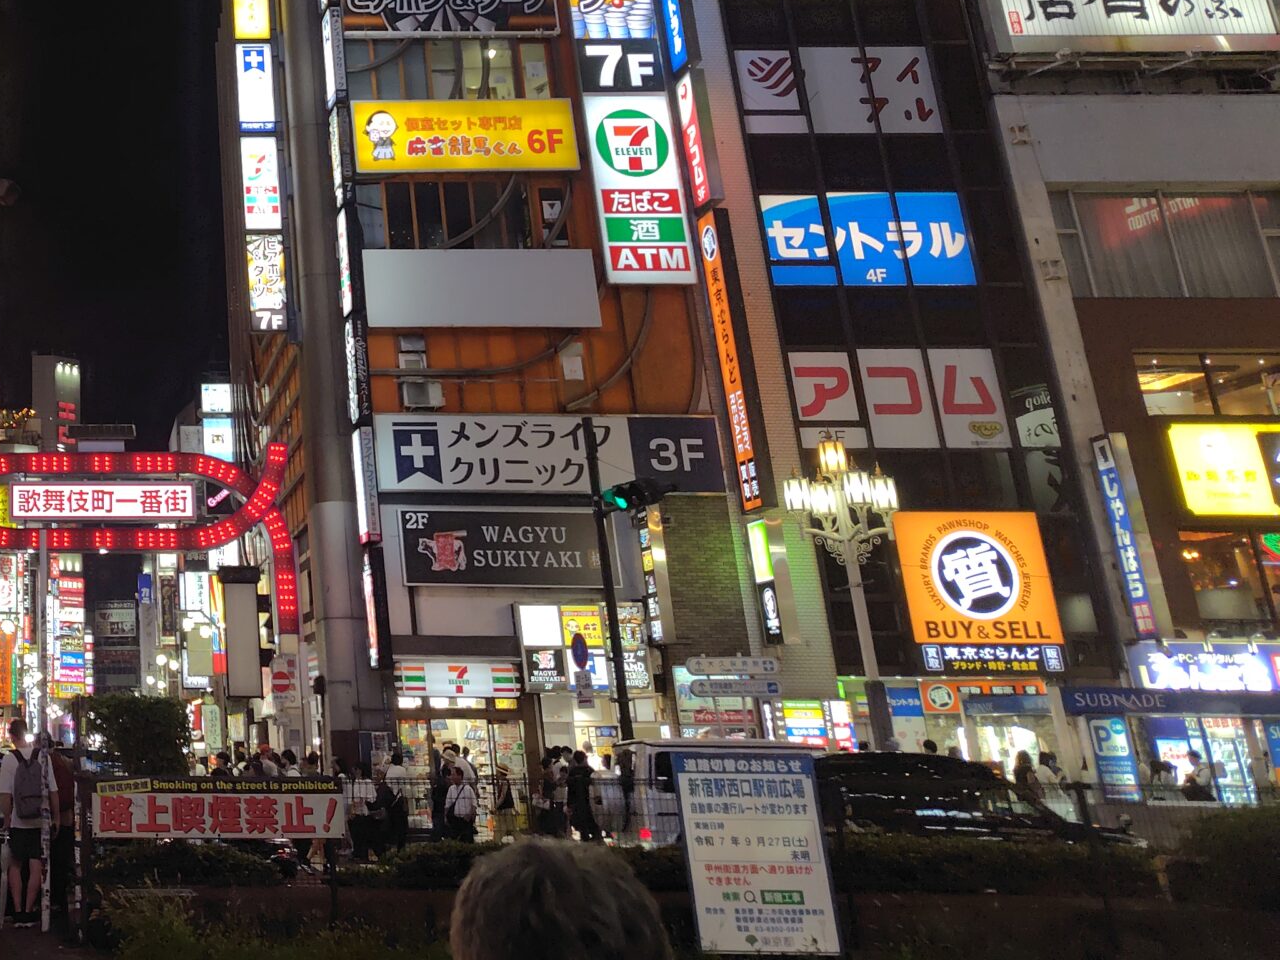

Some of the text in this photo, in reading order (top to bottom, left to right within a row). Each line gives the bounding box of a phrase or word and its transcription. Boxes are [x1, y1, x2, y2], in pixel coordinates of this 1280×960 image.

[585, 44, 654, 87] 7F
[407, 129, 563, 157] 麻雀龍馬くん 6F
[614, 147, 652, 157] ELEVEN
[685, 128, 705, 188] アコム
[611, 191, 674, 212] たばこ
[630, 219, 660, 241] 酒
[767, 220, 968, 260] セントラル
[617, 248, 684, 270] ATM
[866, 268, 888, 283] 4F
[255, 310, 284, 331] 7F
[793, 364, 997, 418] アコム
[728, 392, 745, 454] RESALE
[734, 390, 752, 451] LUXURY
[447, 420, 611, 450] メンズライフ
[648, 437, 705, 472] 3F
[449, 456, 586, 487] クリニック
[17, 489, 188, 514] 歌舞伎町一番街
[405, 512, 429, 529] 2F
[481, 525, 567, 545] WAGYU
[472, 549, 582, 569] SUKIYAKI
[920, 518, 1032, 612] LUXURY BRANDS PAWNSHOP WATCHES JEWELRY
[941, 542, 1011, 611] 質
[944, 646, 1040, 660] 東京ぶらんど
[1074, 692, 1167, 710] SUBNADE
[1093, 725, 1111, 752] P
[683, 758, 802, 773] 道路切替のお知らせ
[153, 780, 338, 793] Smoking on the street is prohibited.
[687, 777, 806, 799] 新宿駅西口駅前広場
[690, 803, 808, 815] 自動車の通行ルートが変わります
[706, 876, 752, 887] できません
